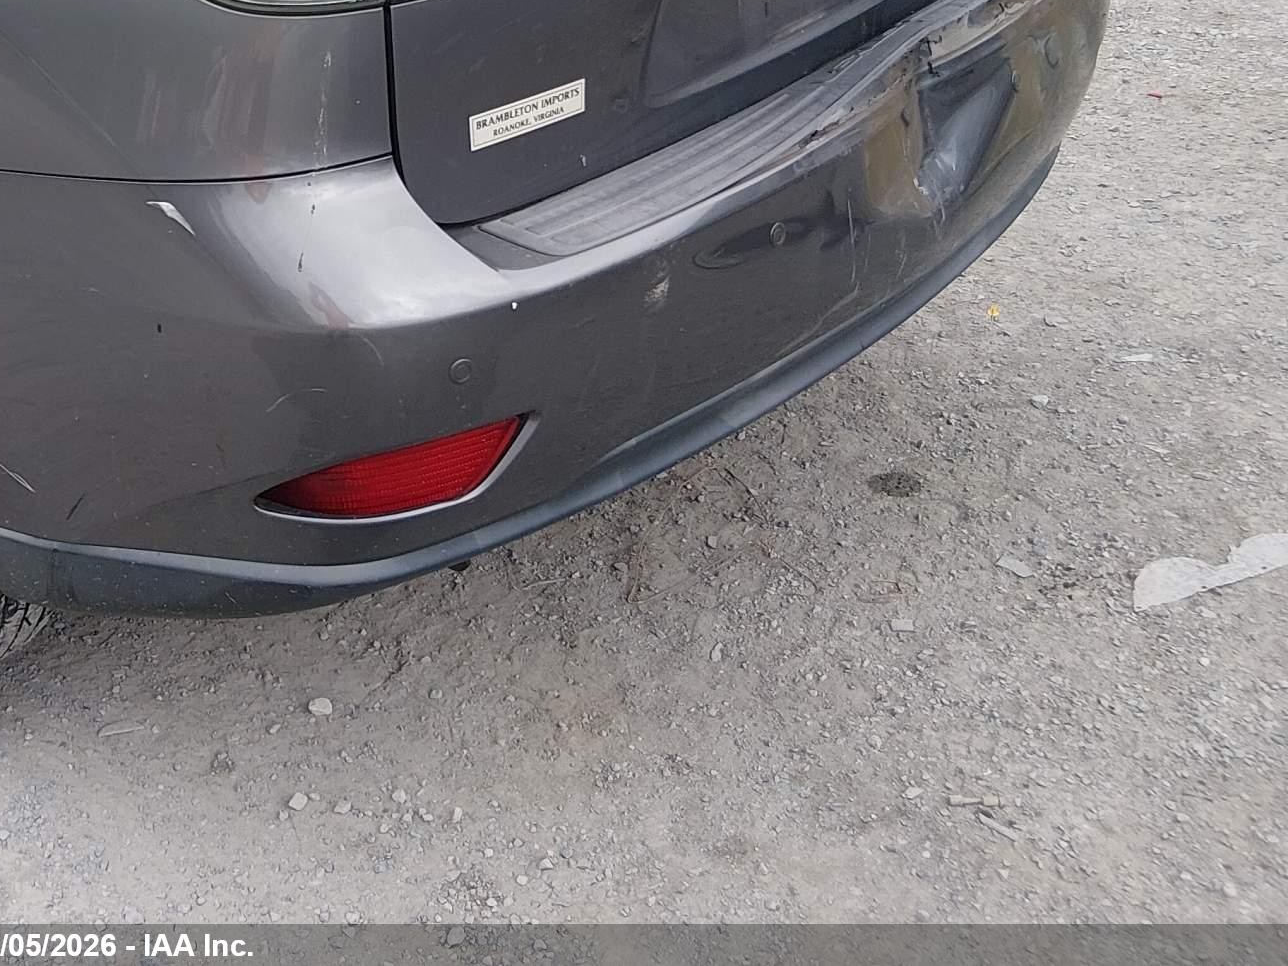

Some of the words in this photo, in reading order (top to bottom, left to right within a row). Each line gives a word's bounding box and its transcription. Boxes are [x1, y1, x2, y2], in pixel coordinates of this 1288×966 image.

[476, 102, 538, 130] BRAMBLETON
[541, 87, 580, 107] IMPORTS
[533, 106, 565, 123] VIRGINIA
